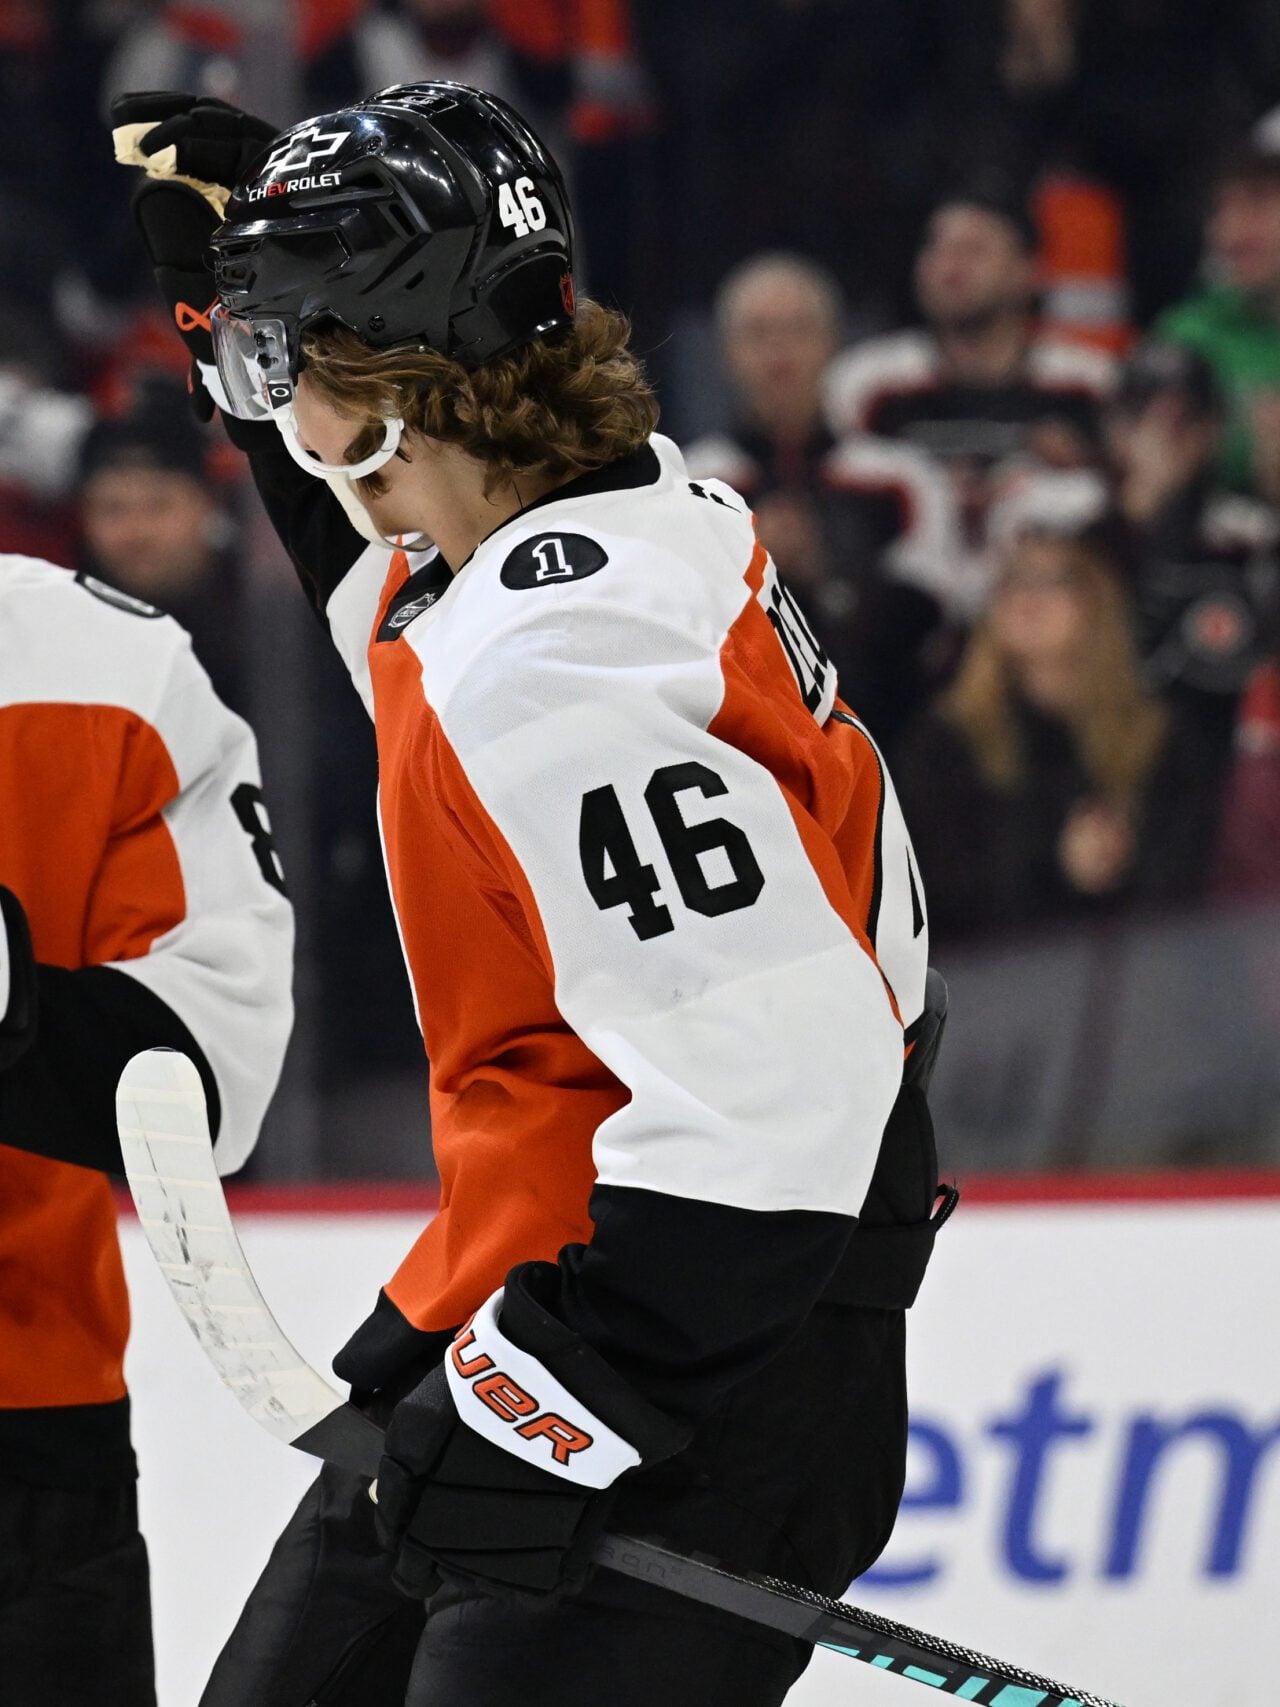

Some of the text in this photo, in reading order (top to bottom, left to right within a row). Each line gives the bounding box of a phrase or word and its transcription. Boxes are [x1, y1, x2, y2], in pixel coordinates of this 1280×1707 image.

[248, 172, 342, 203] CHEVROLET
[498, 176, 547, 239] 46
[531, 538, 574, 582] 1
[579, 761, 766, 941] 46
[451, 1313, 594, 1467] UER
